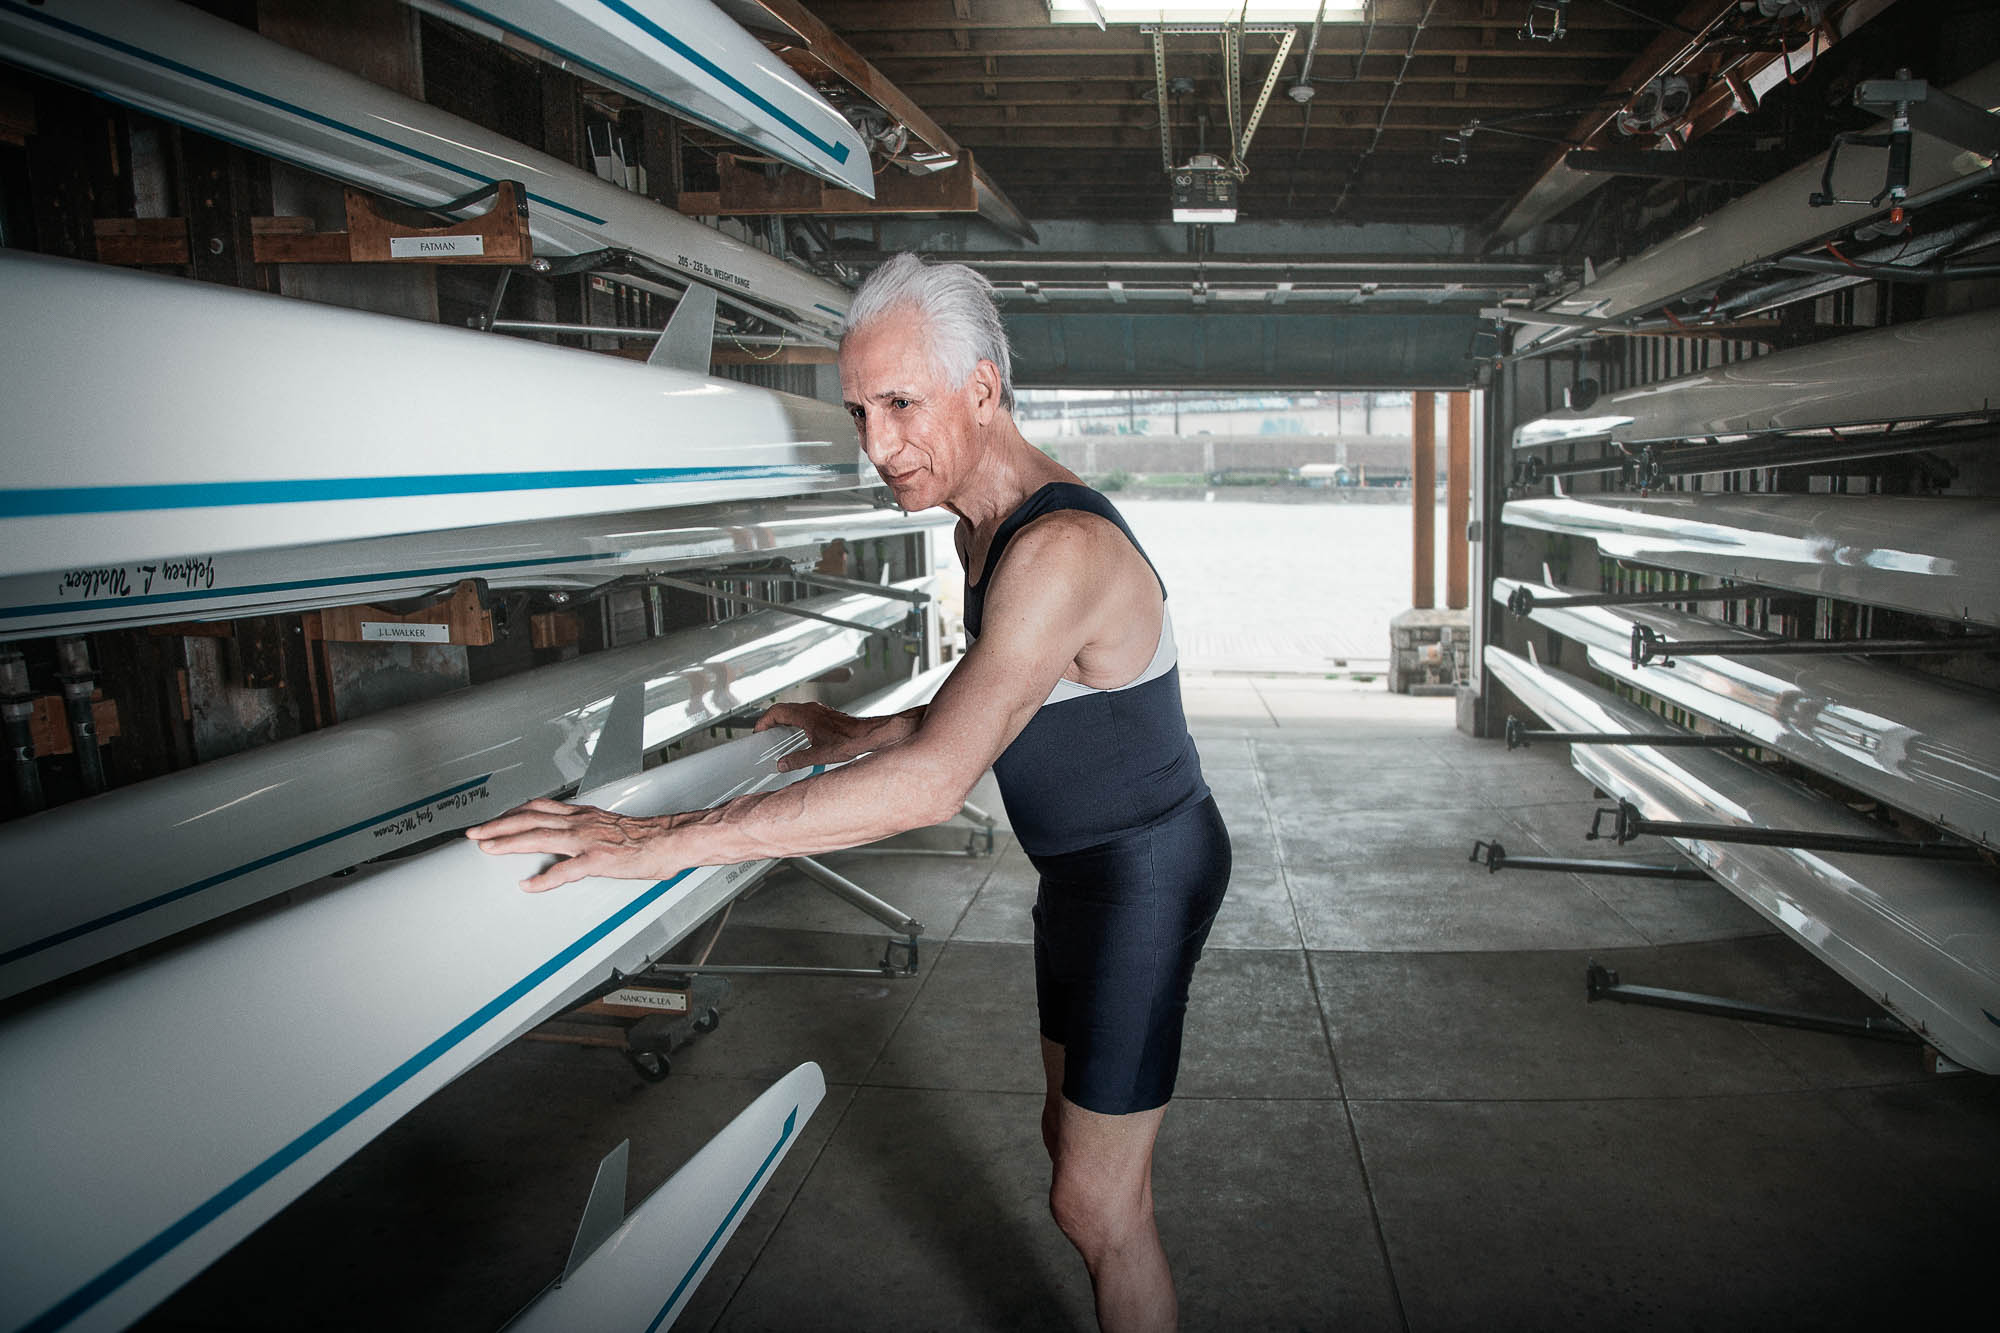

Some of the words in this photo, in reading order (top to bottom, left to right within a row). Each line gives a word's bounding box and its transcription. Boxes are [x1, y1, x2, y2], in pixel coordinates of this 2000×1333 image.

[420, 242, 456, 251] FATMAN
[678, 254, 689, 267] 205
[693, 260, 703, 273] 235
[713, 268, 734, 283] WEIGHT
[734, 275, 752, 289] RANGE
[136, 565, 157, 595] L.
[162, 556, 215, 589] Jeffrey
[620, 993, 648, 1003] NANCY
[656, 997, 671, 1006] LEA
